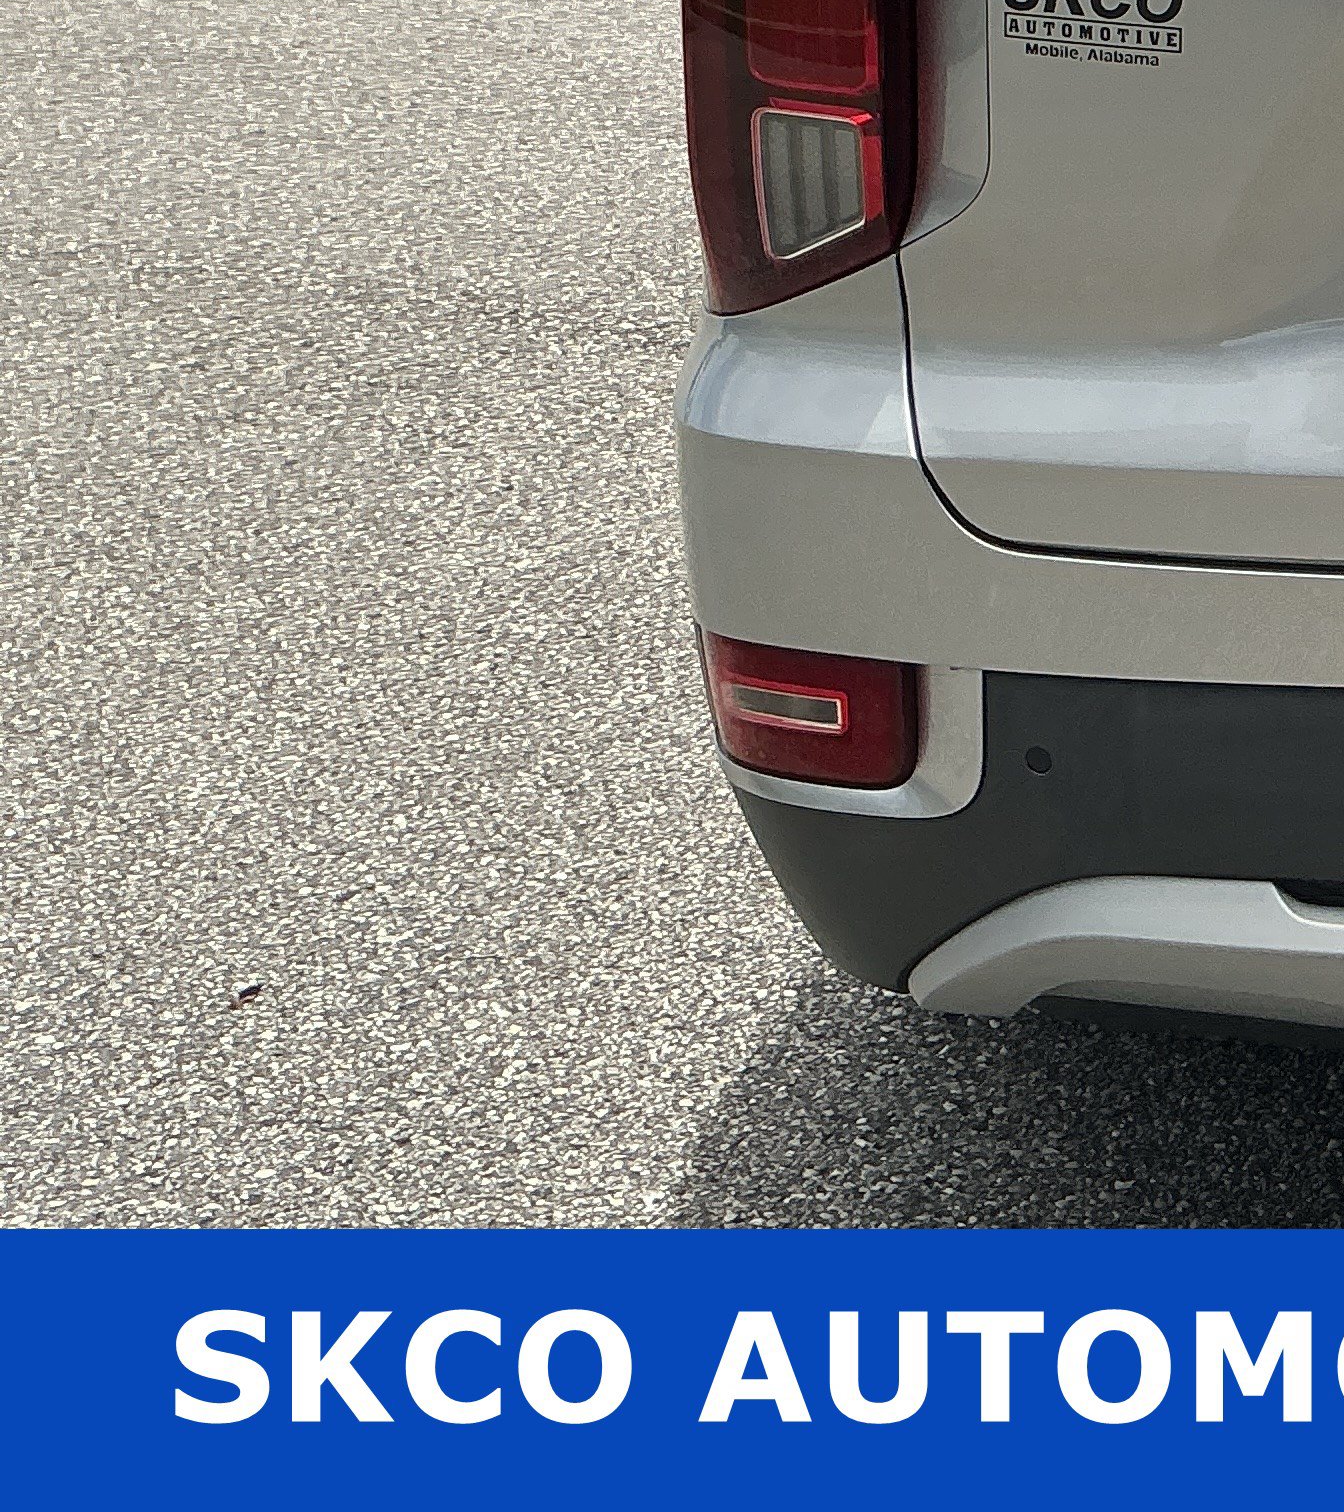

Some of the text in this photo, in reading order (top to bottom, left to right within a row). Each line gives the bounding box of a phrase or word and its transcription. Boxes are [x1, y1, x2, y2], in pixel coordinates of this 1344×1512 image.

[1008, 17, 1179, 48] AUTOMOTIVE
[1025, 42, 1161, 67] Mobile, Alabama
